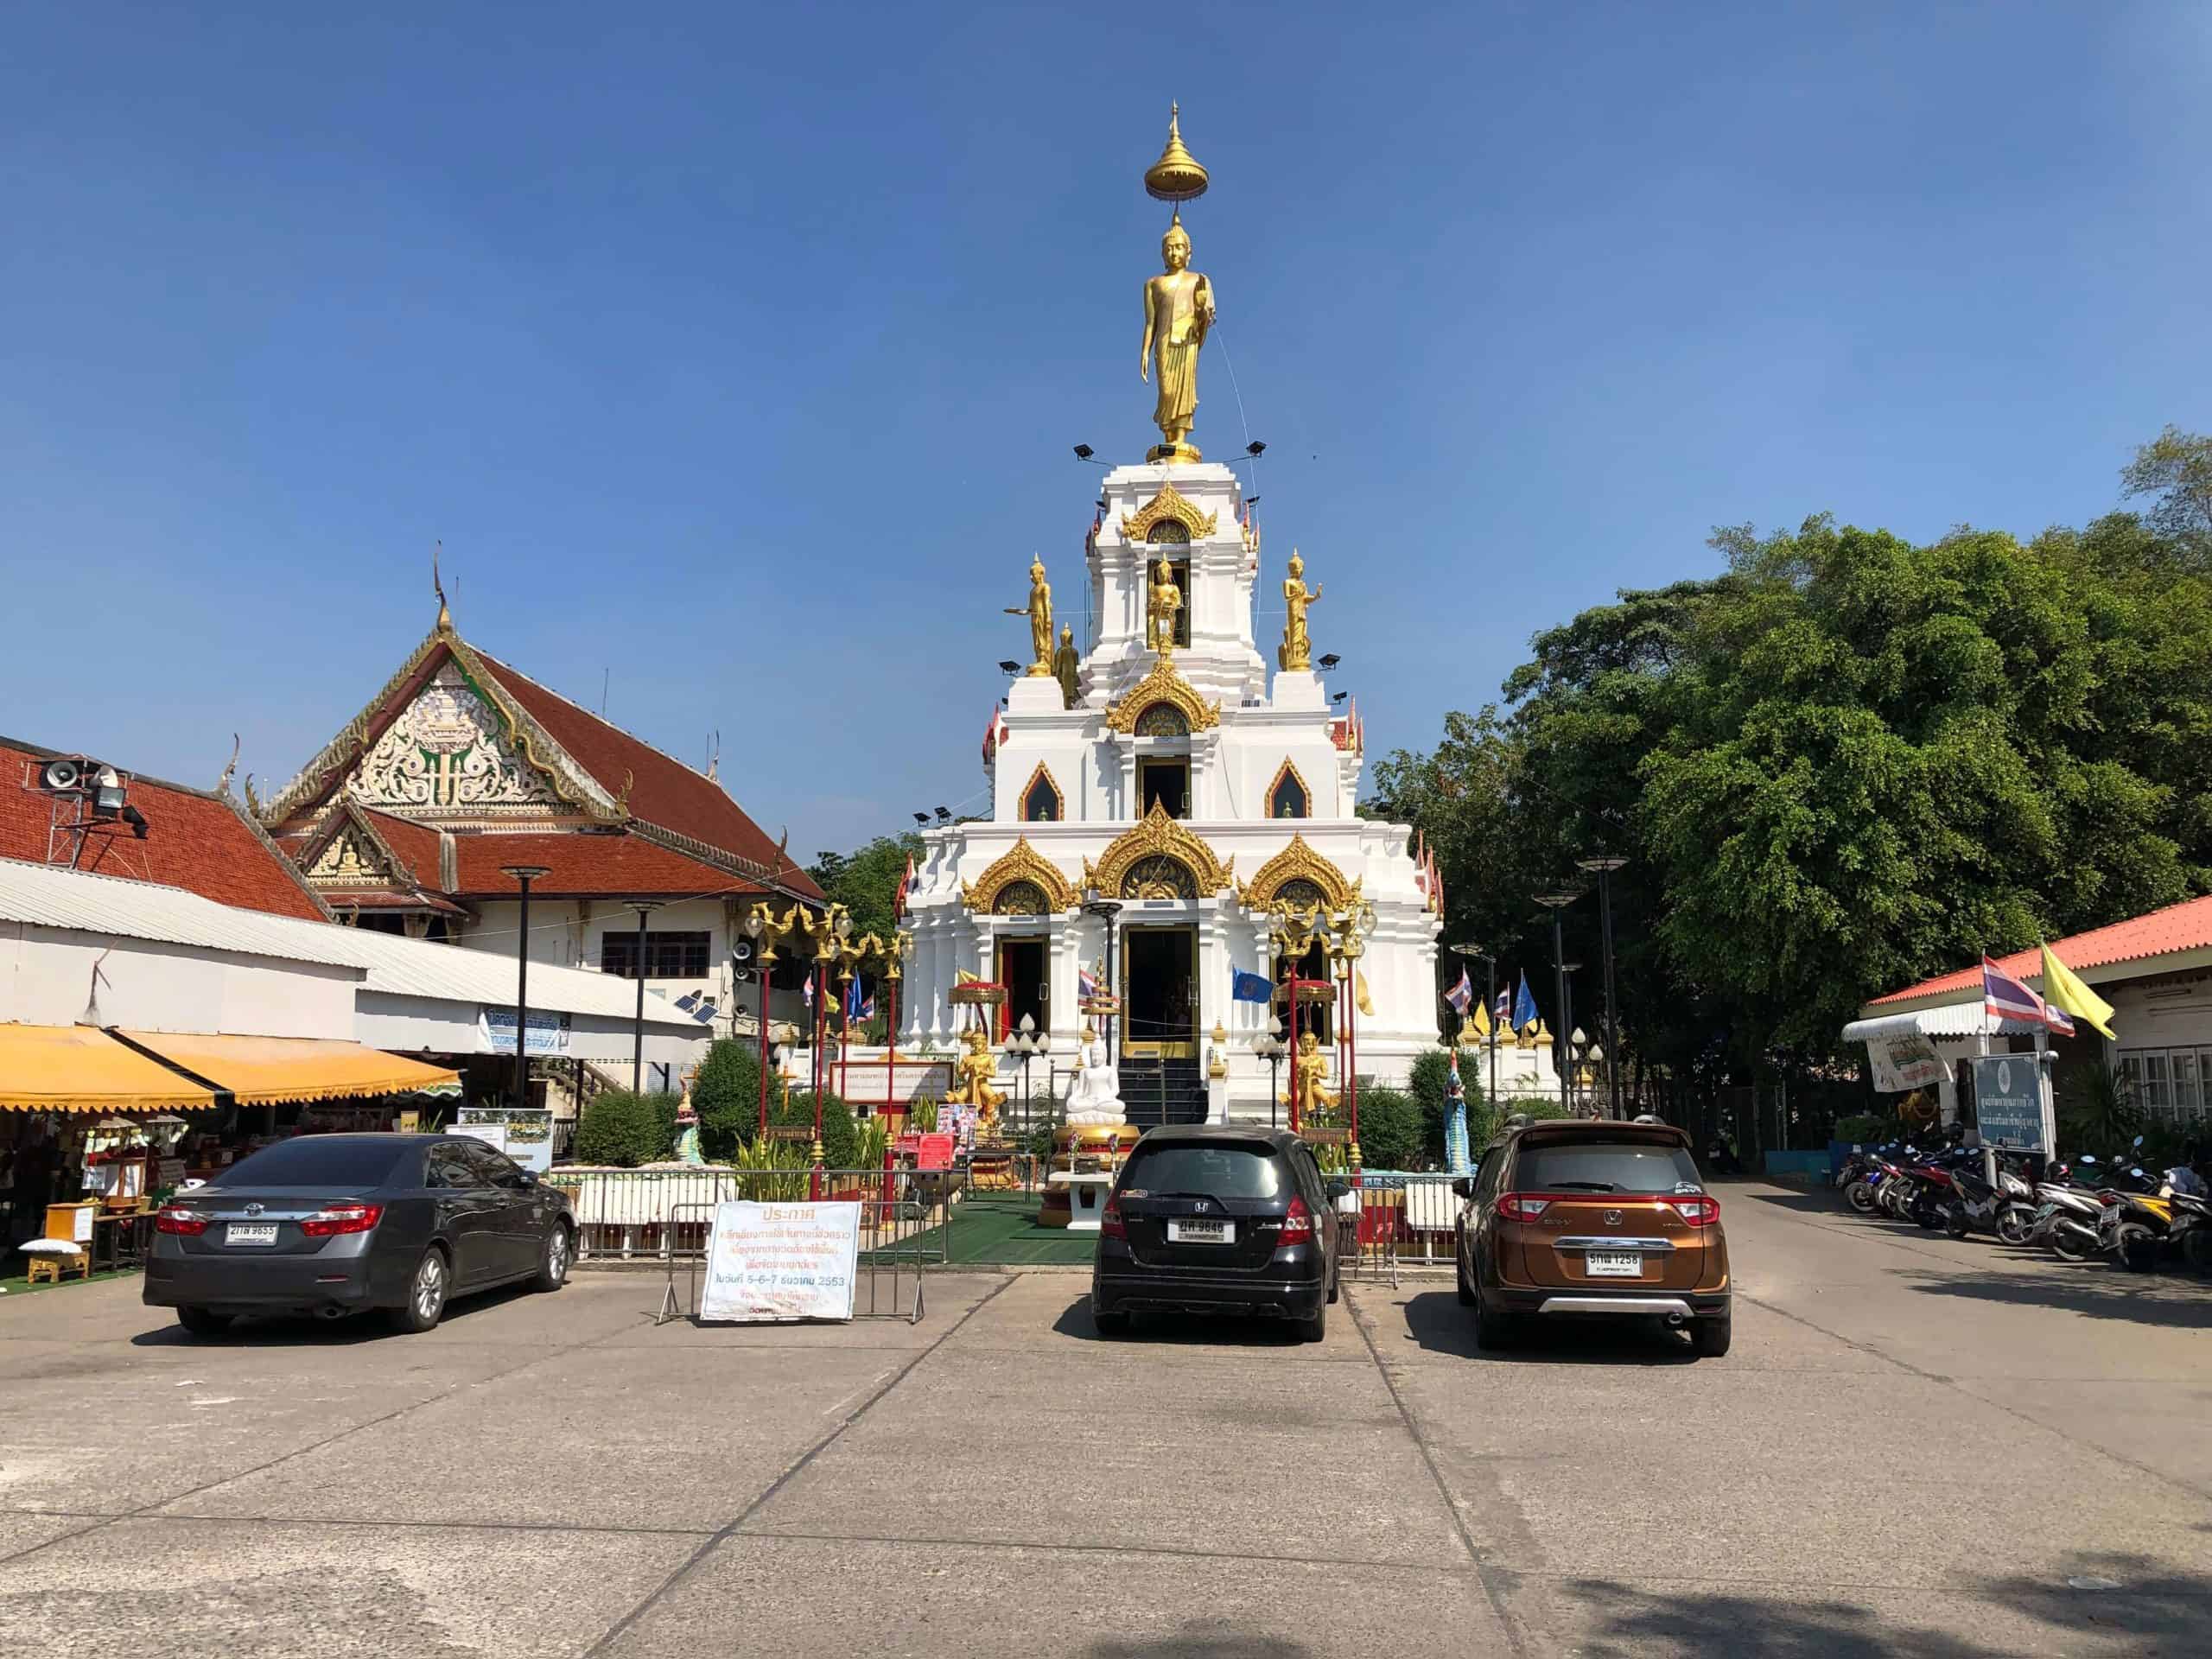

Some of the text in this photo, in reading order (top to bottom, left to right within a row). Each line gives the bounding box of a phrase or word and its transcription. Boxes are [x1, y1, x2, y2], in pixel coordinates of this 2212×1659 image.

[763, 1205, 816, 1220] ประกาศ
[1613, 1254, 1638, 1264] 1258
[747, 1275, 777, 1285] 5-6-7
